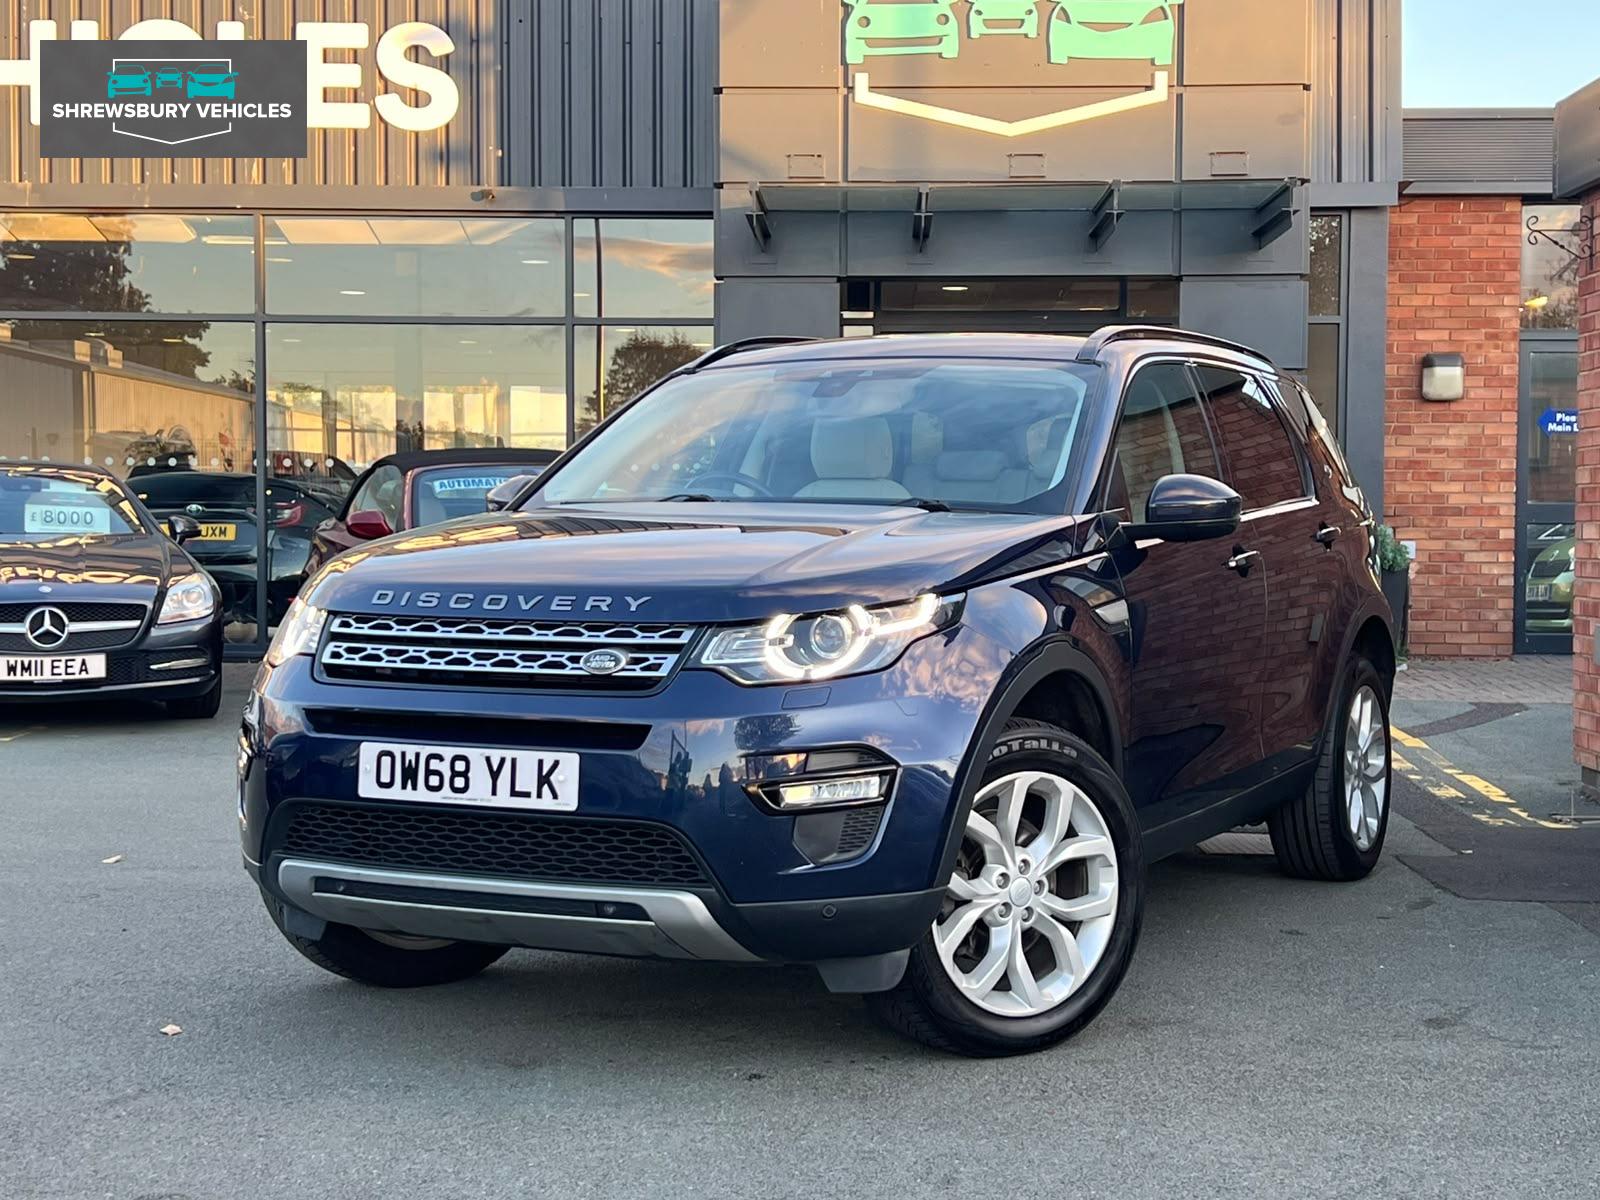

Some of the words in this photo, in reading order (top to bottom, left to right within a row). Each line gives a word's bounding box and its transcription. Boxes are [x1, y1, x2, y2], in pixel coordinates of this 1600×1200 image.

[1547, 423, 1572, 432] Main
[439, 478, 508, 490] AUTOMATI
[201, 525, 228, 538] JXM
[371, 589, 652, 613] DISCOVERY
[50, 658, 90, 675] EEA
[375, 749, 471, 795] OW68
[485, 755, 561, 801] YLK
